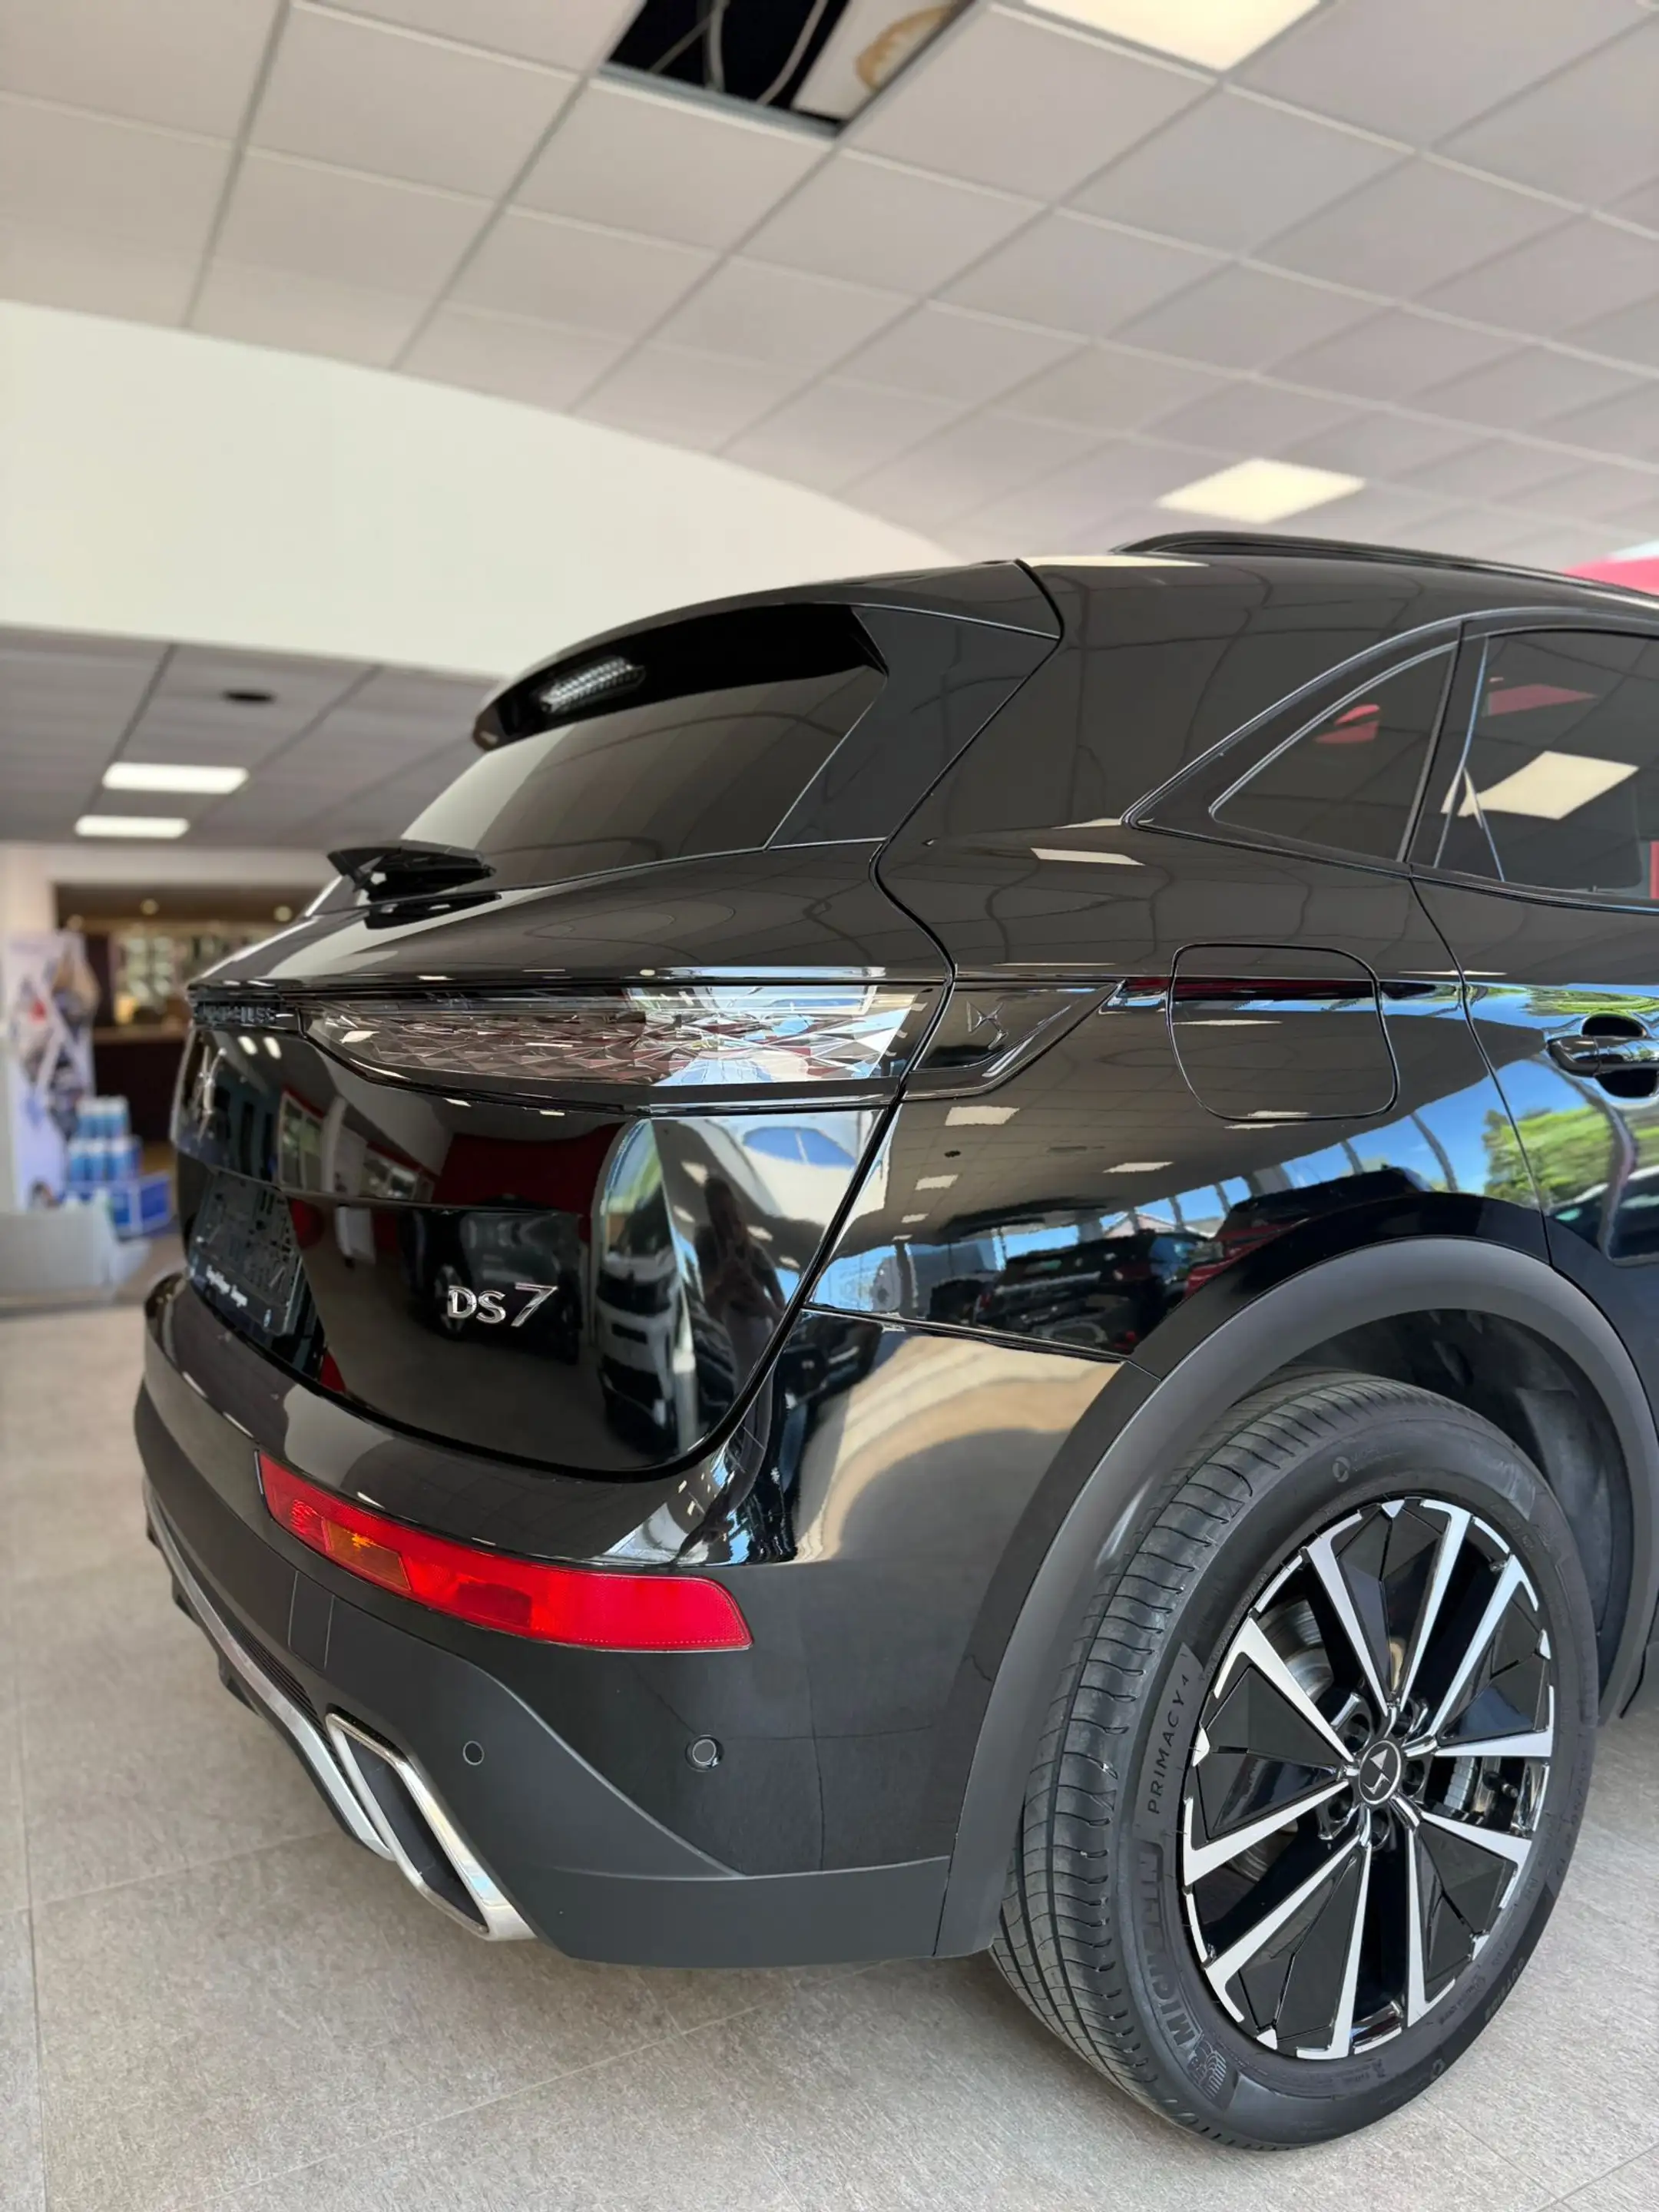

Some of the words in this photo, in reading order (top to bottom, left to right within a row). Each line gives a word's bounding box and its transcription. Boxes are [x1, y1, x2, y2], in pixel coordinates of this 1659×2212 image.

[447, 1285, 506, 1324] DS
[510, 1282, 558, 1327] 7
[1147, 1690, 1184, 1814] PRIMACY
[1138, 1851, 1196, 2046] MICHELIN
